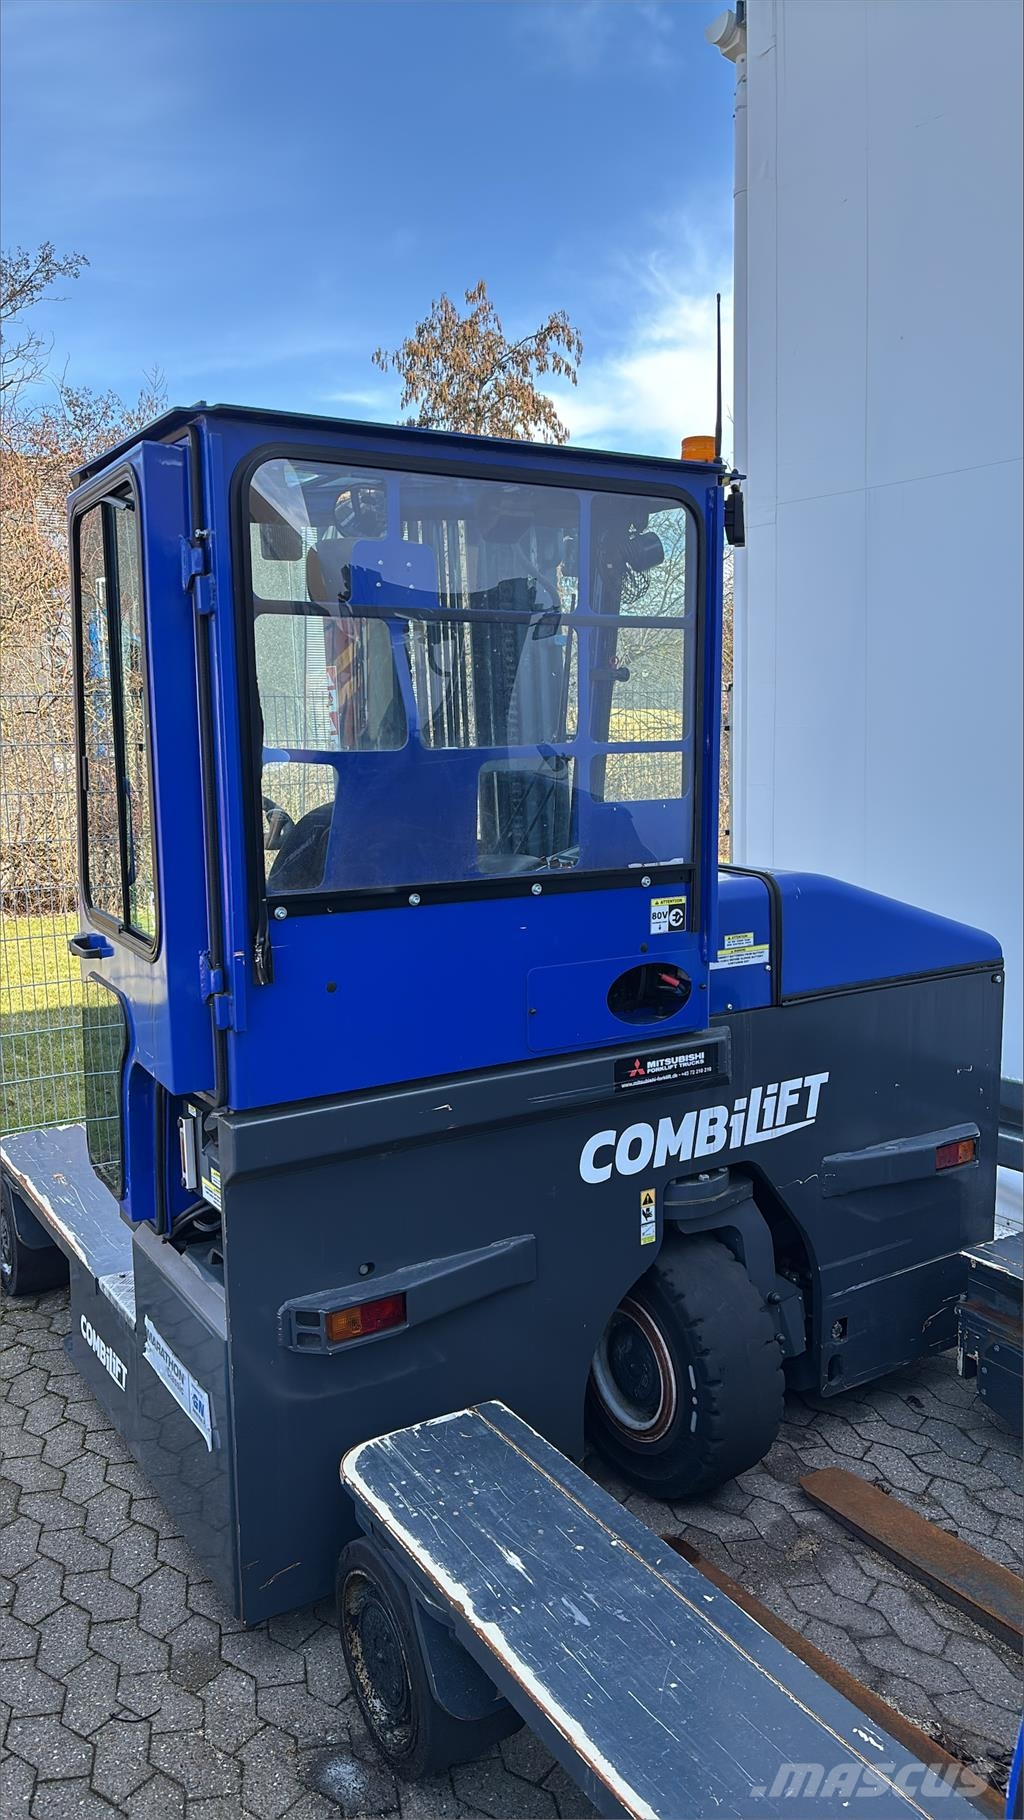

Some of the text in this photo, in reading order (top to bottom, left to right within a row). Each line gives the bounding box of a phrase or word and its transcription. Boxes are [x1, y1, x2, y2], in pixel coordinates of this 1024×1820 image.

[652, 911, 668, 920] 80V
[646, 1051, 705, 1068] MITSUBISHI
[646, 1059, 705, 1074] FORKLIFT TRUCKS
